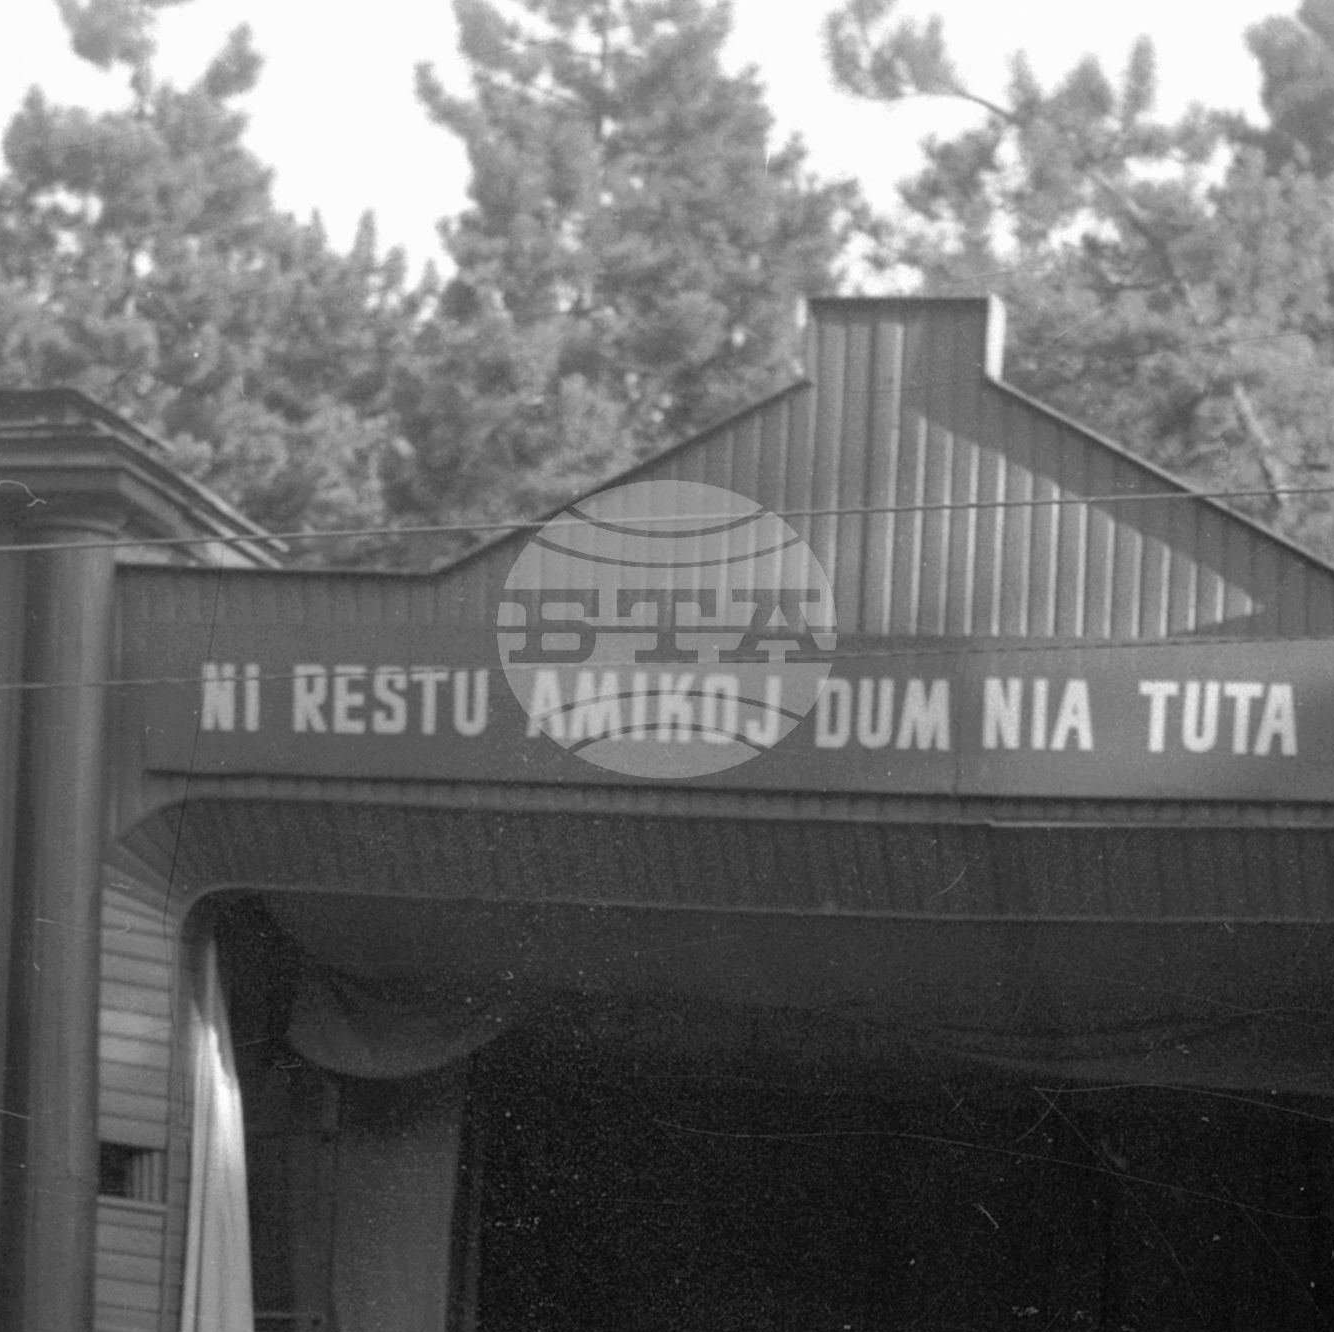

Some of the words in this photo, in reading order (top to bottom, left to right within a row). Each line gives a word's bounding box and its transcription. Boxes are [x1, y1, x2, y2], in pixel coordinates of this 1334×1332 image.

[201, 662, 261, 732] NI
[292, 664, 490, 737] RESTU
[525, 669, 783, 745] AMIKOJ
[814, 677, 952, 752] DUM
[981, 677, 1094, 752] NIA
[1138, 680, 1299, 757] TUTA
